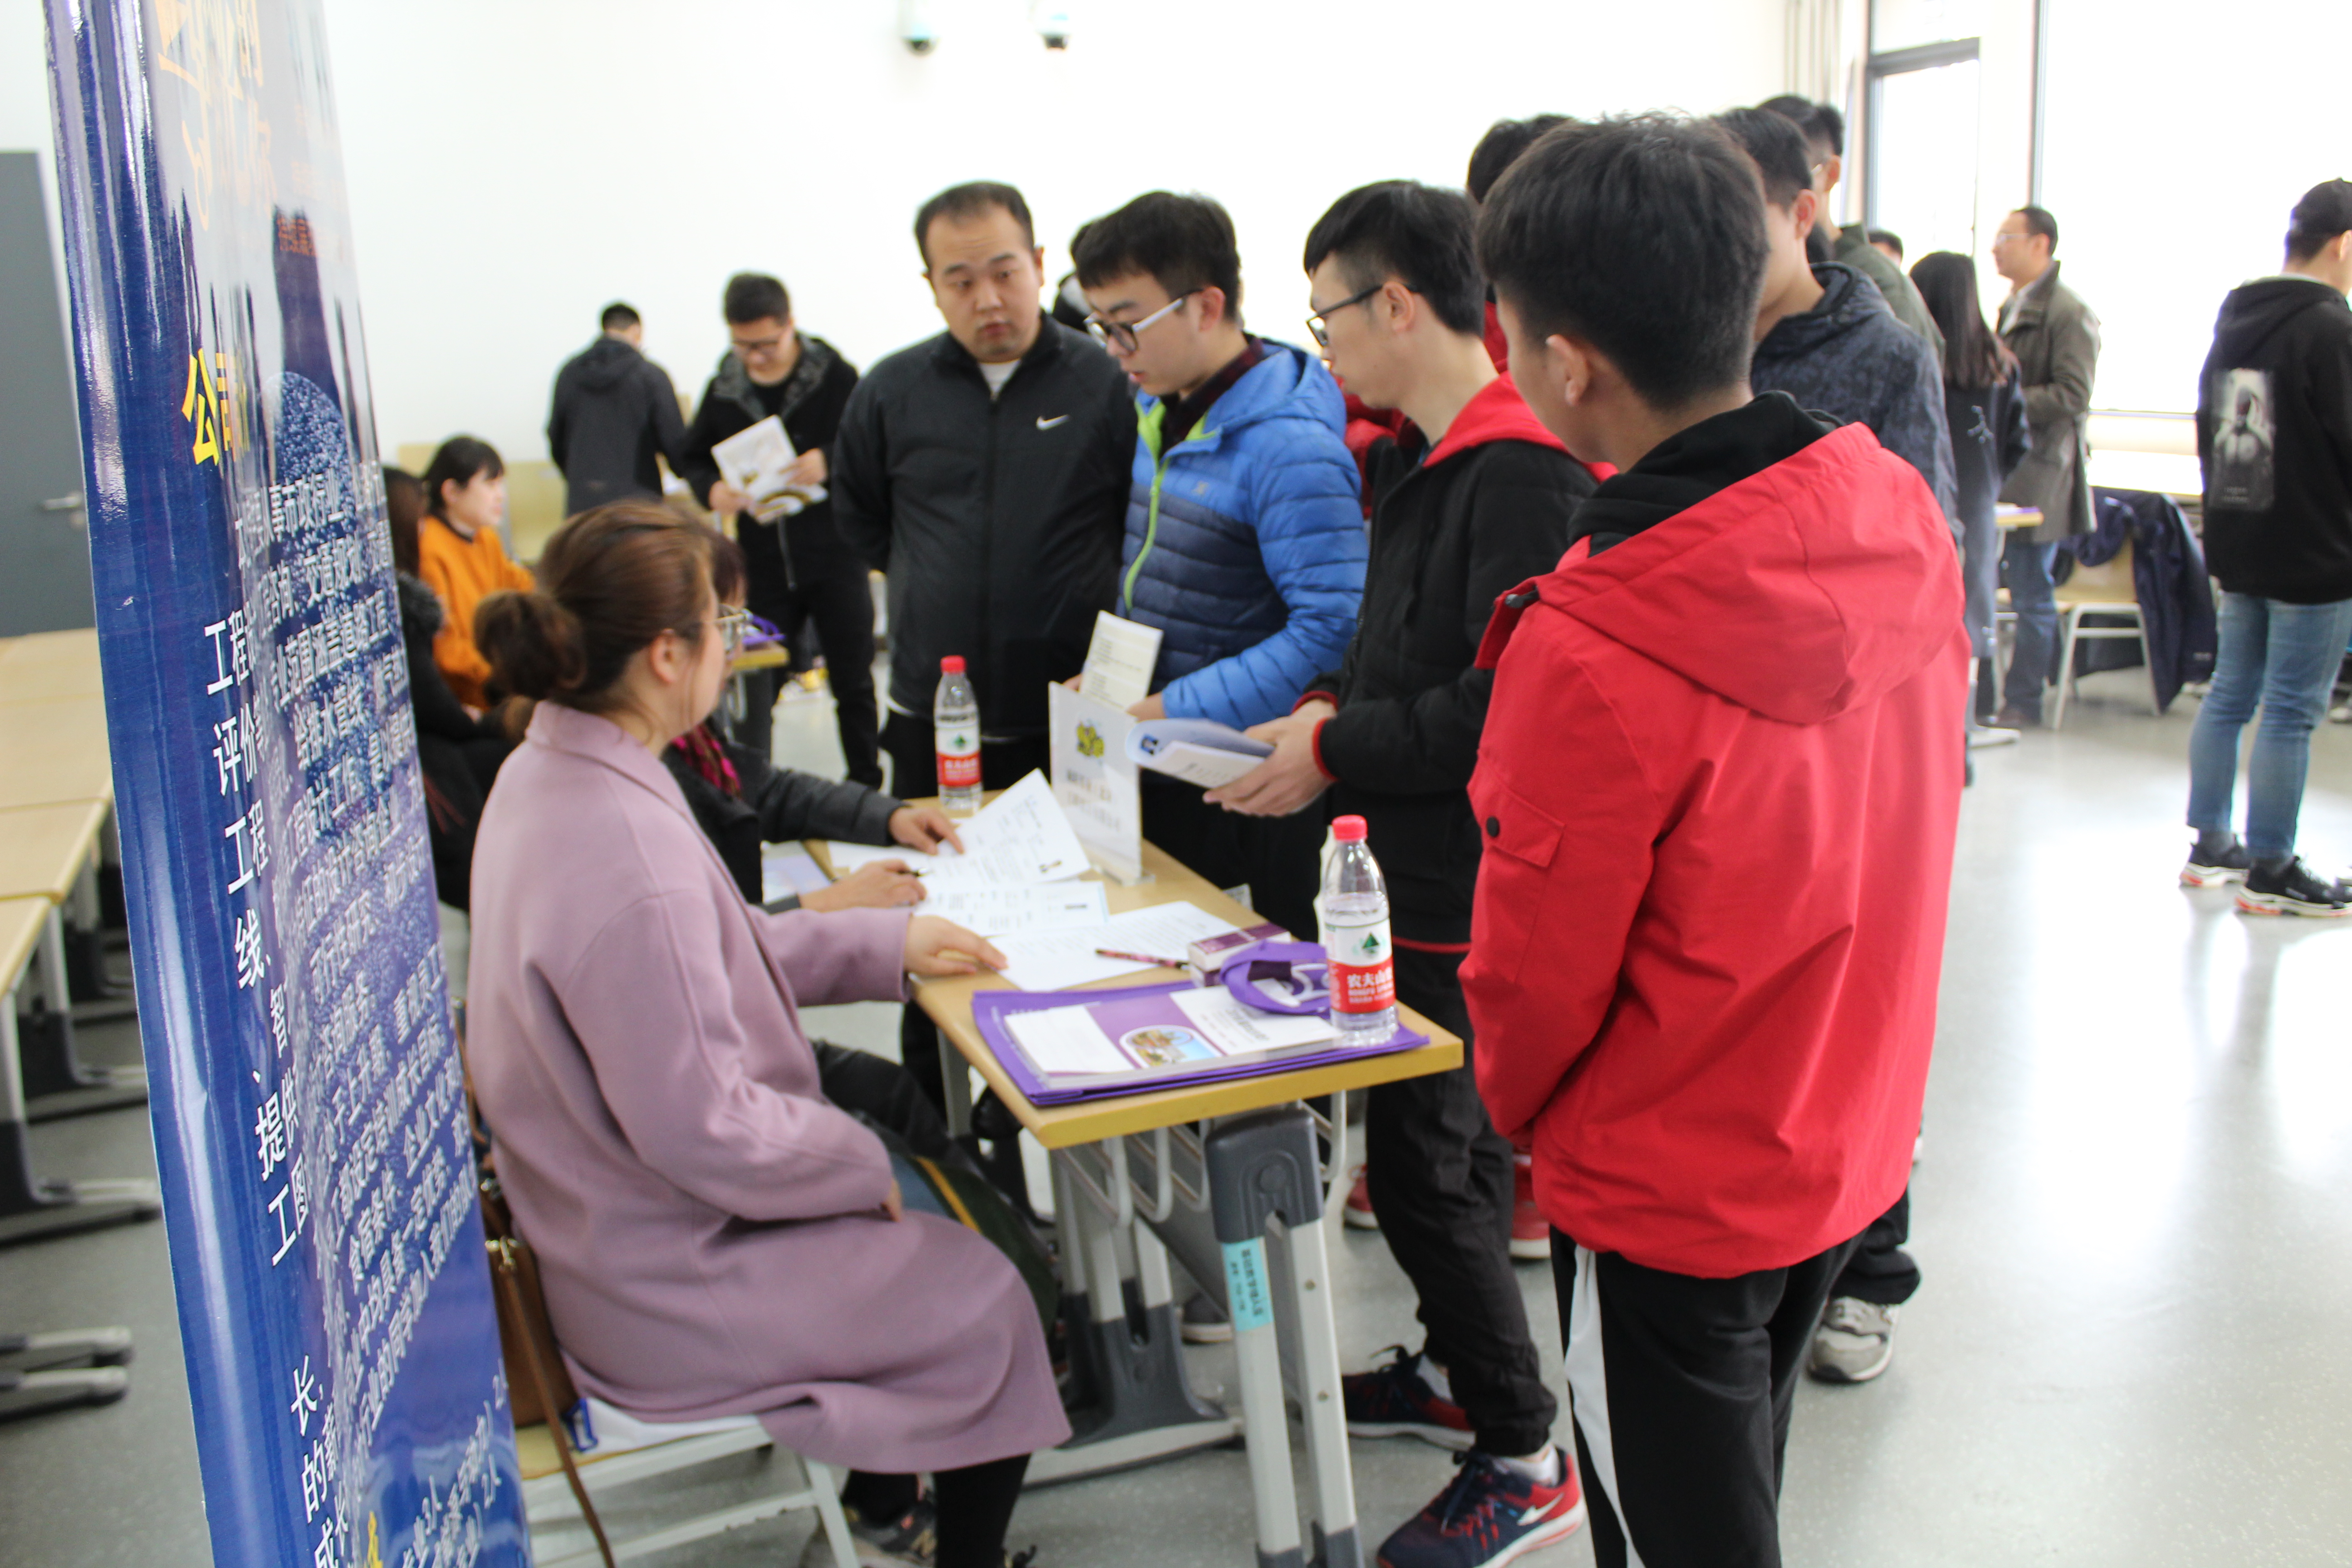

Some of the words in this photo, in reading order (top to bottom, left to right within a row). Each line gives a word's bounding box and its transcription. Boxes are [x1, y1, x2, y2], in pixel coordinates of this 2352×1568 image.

[204, 610, 249, 695] 工程
[213, 702, 257, 796] 评价
[255, 1066, 298, 1181] 提供
[269, 1152, 309, 1267] 工图
